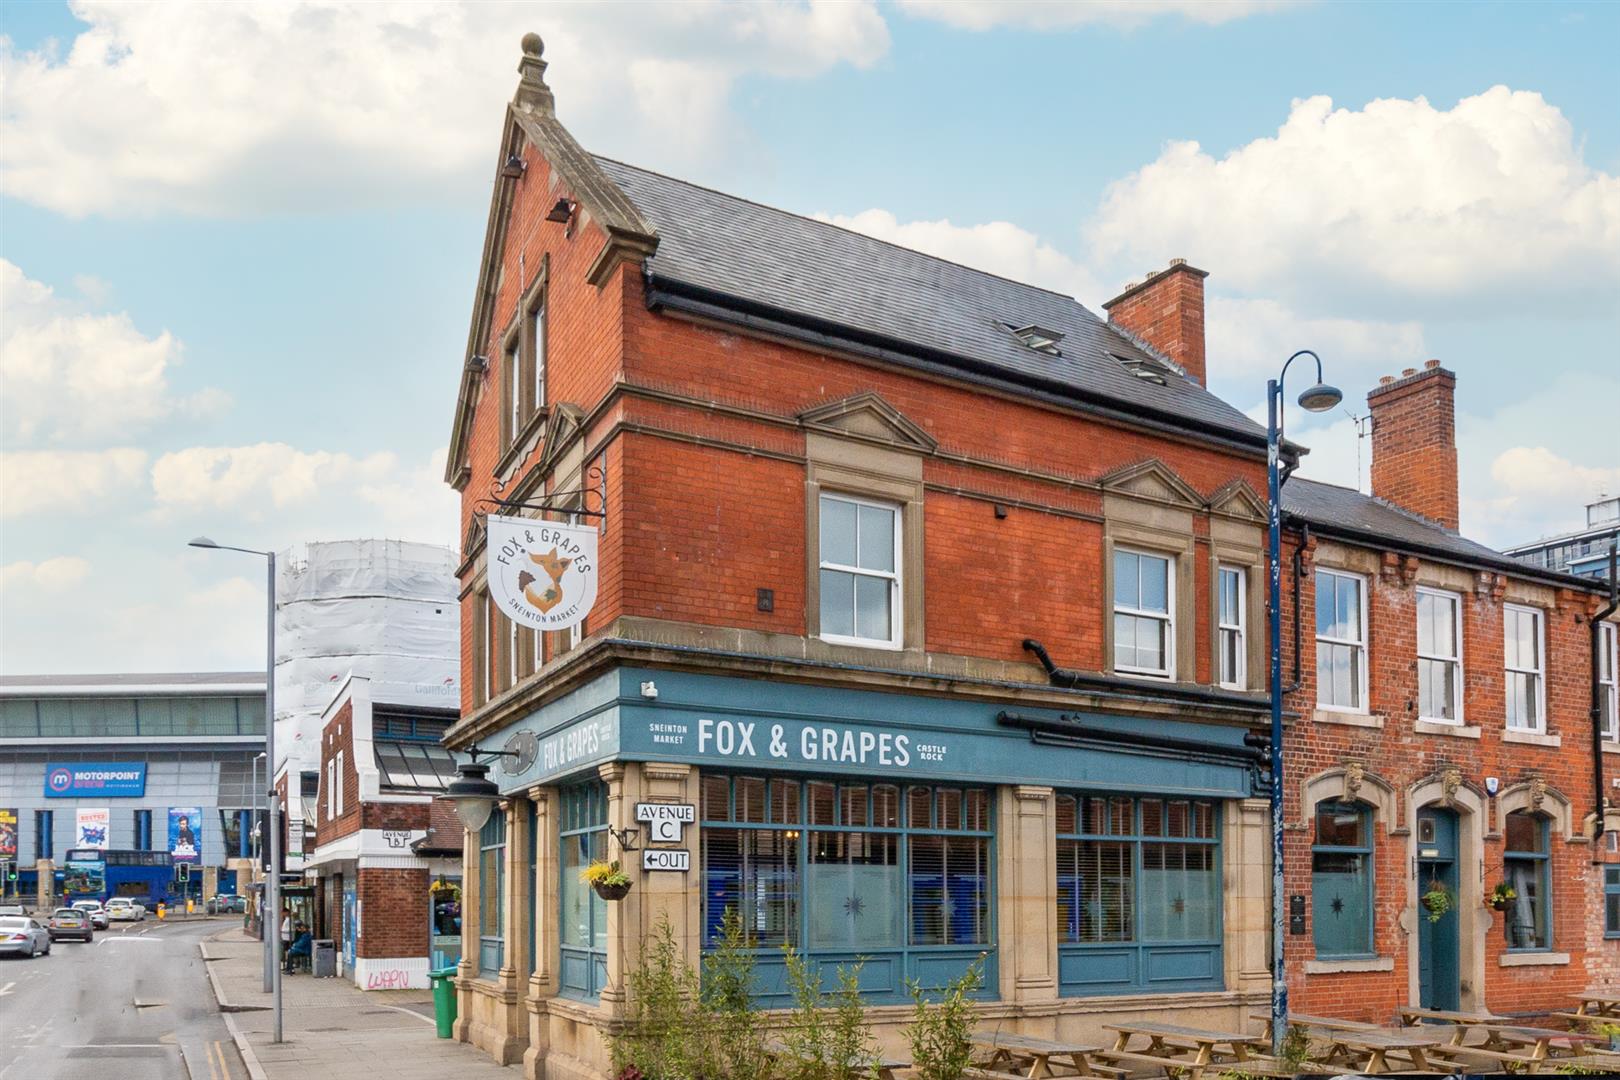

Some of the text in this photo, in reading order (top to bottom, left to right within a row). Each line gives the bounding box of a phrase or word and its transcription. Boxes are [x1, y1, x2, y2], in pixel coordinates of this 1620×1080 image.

[497, 528, 591, 574] FOX & GRAPES
[509, 598, 579, 622] SNEINTON MARKET
[649, 723, 687, 734] SNEINTON
[543, 739, 559, 771] FOX
[559, 738, 566, 765] &
[566, 722, 600, 763] GRAPES
[653, 735, 684, 744] MARKET
[698, 719, 910, 767] FOX & GRAPES
[916, 744, 947, 754] CASTLE
[920, 752, 943, 761] ROCK
[74, 772, 140, 781] MOTORPOINT
[640, 806, 692, 820] AVENUE
[659, 821, 673, 839] C
[658, 852, 687, 868] OUT
